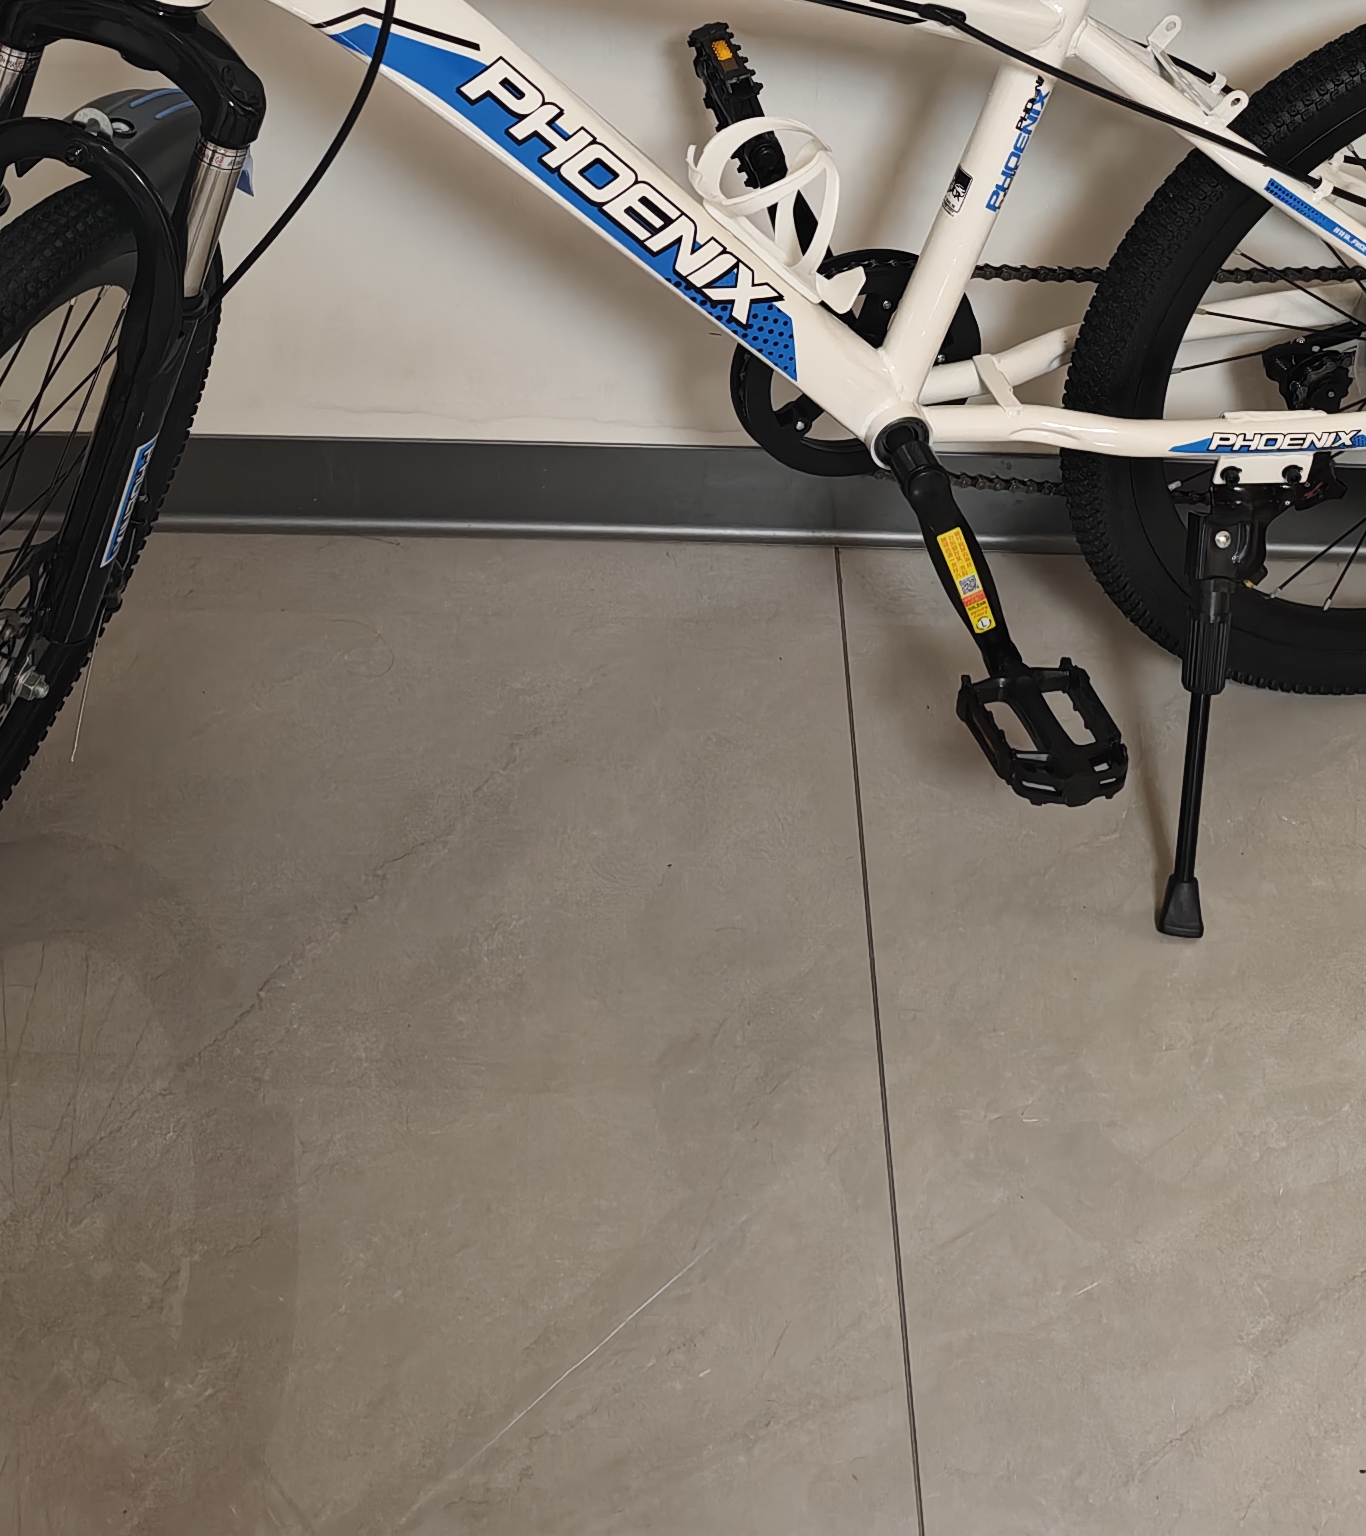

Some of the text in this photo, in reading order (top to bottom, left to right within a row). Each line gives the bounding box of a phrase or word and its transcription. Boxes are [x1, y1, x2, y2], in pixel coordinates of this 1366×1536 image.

[458, 56, 786, 328] PHOENIX
[985, 89, 1050, 212] PHOENIX
[1207, 428, 1362, 453] PHOENIX
